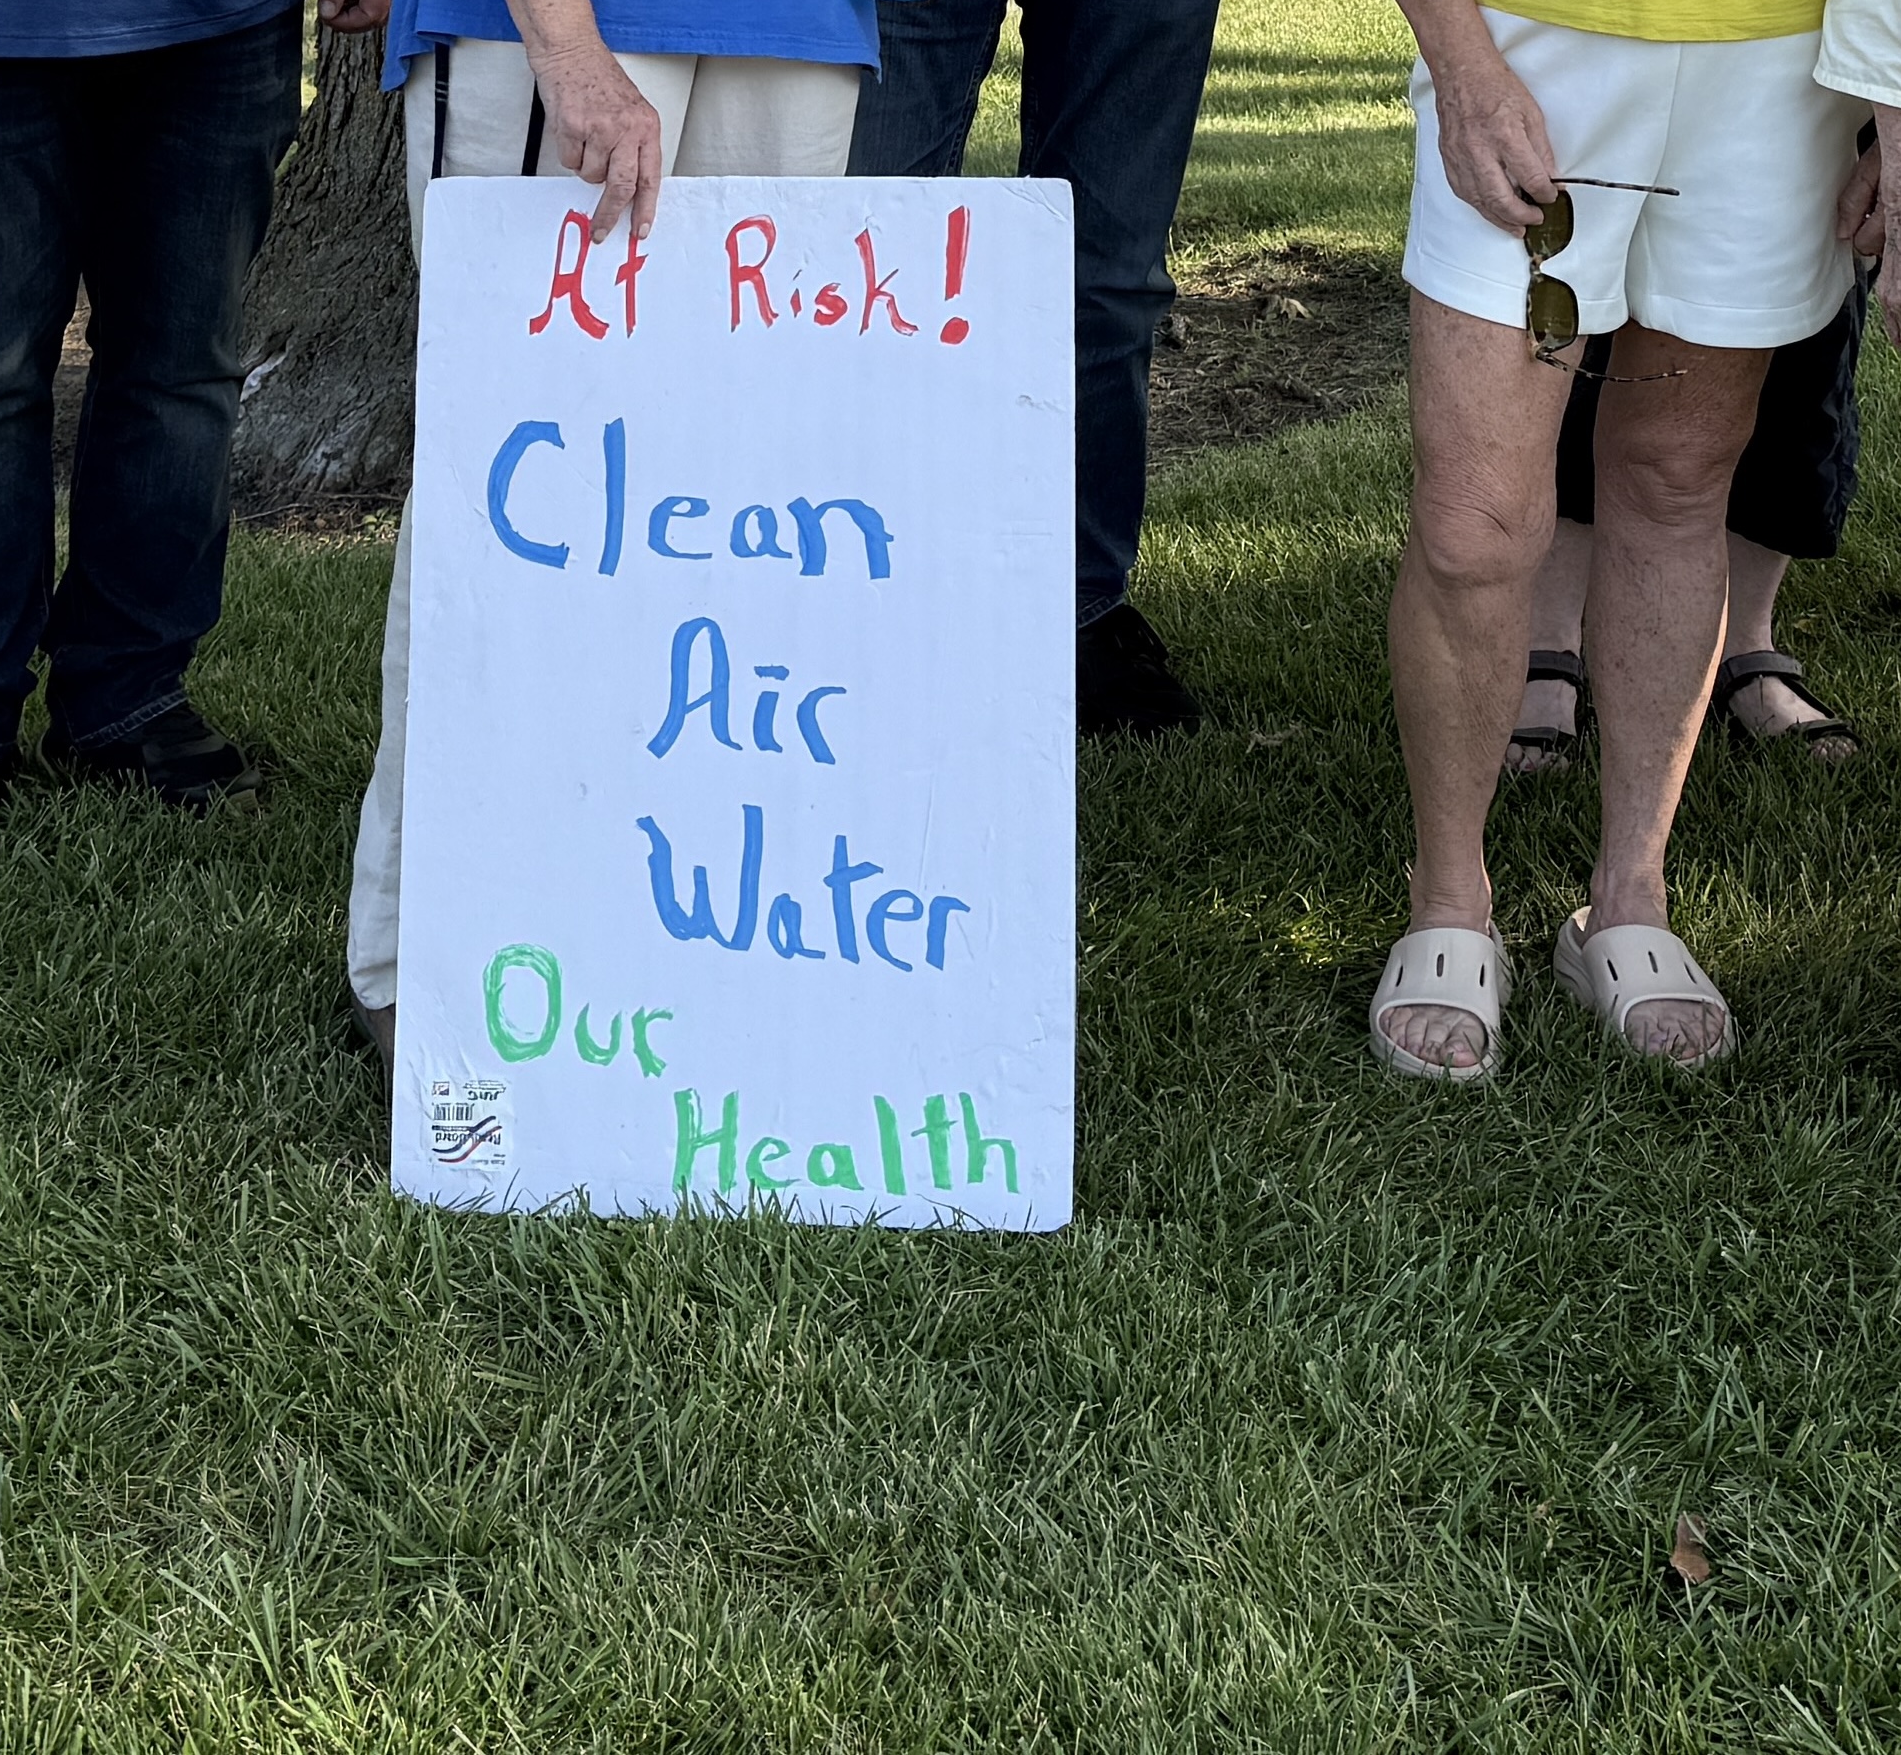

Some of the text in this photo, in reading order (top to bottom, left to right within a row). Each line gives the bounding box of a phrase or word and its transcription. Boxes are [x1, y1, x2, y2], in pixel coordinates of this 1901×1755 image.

[724, 204, 972, 346] Risk!
[486, 416, 895, 580] Clean
[646, 617, 848, 765] Air
[634, 803, 972, 973] Water
[481, 942, 675, 1079] Our
[671, 1087, 1020, 1196] Health
